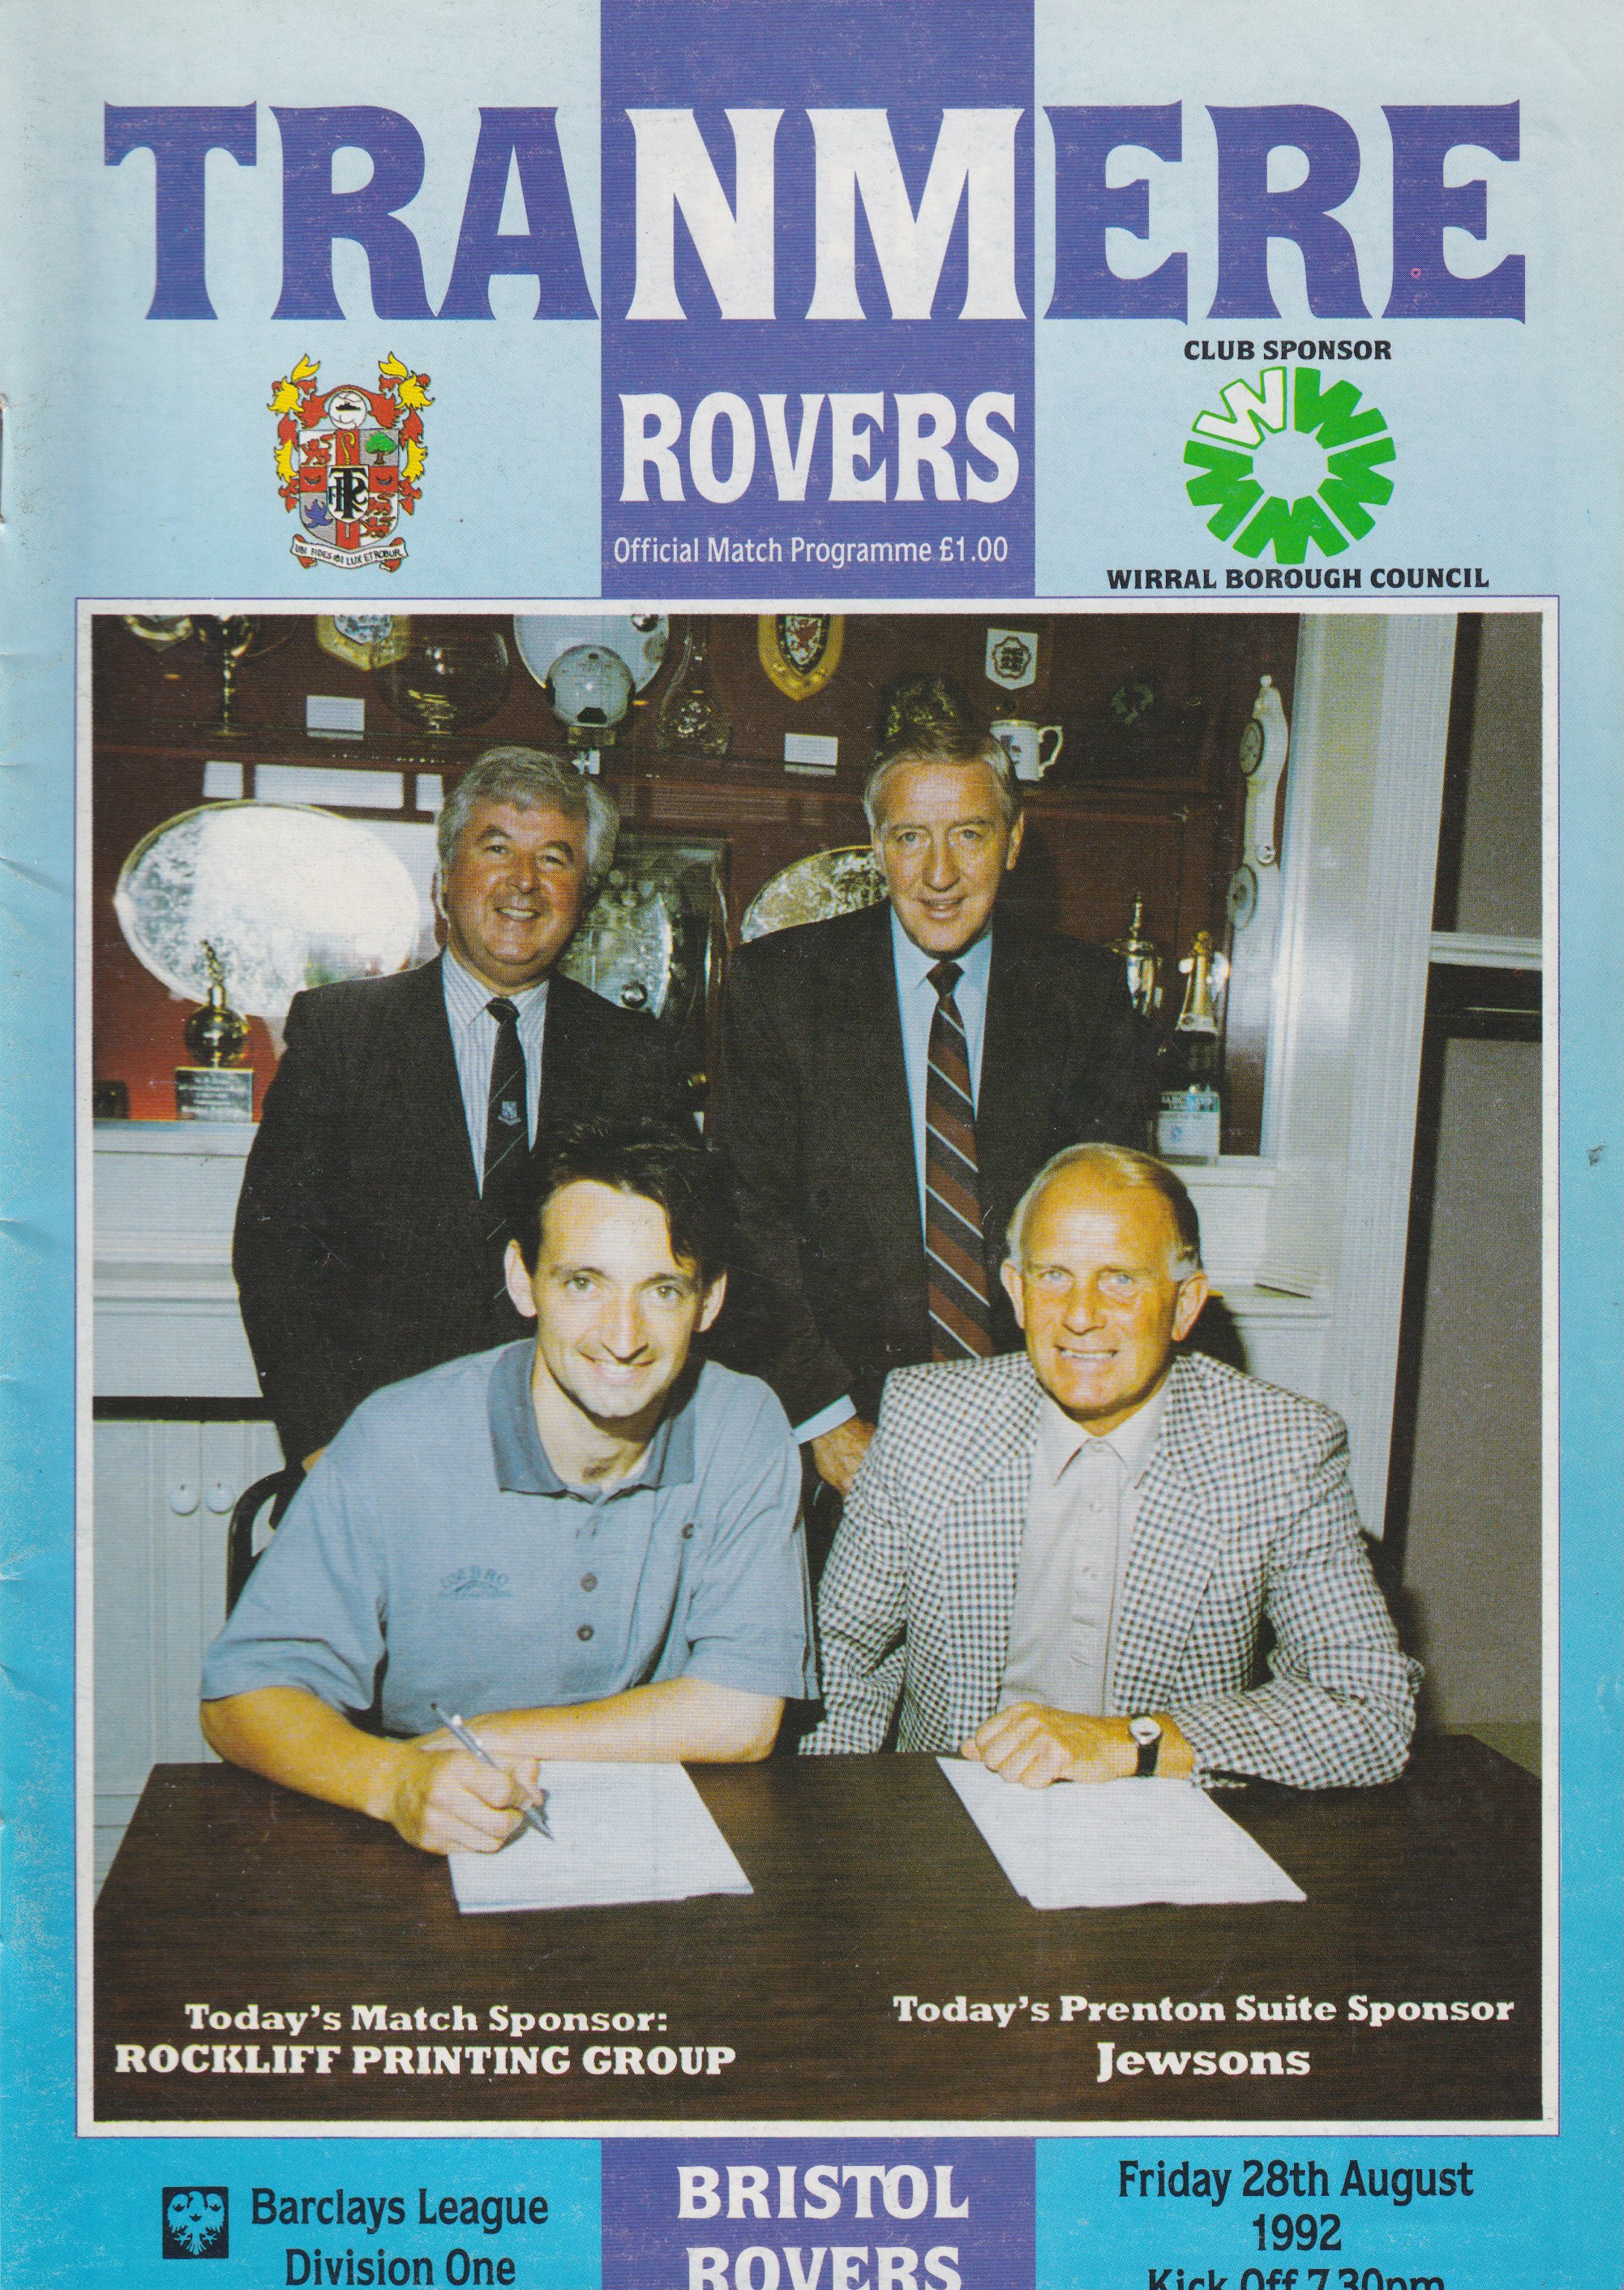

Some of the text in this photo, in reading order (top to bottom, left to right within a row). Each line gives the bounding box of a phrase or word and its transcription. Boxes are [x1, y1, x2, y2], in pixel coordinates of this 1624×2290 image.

[105, 101, 1525, 322] TRANMERE
[1184, 340, 1392, 361] CLUB SPONSOR
[619, 392, 1019, 503] ROVERS
[311, 547, 332, 560] FIDES
[346, 555, 362, 566] LUX
[614, 536, 1008, 568] Official Match Programme £1.00
[1107, 568, 1489, 590] WIRRAL BOROUGH COUNCIL
[185, 2005, 668, 2037] Today's Match Sponsor:
[893, 1995, 1515, 2028] Today's Prenton Suite Sponsor
[115, 2044, 736, 2075] ROCKLIFF PRINTING GROUP
[1097, 2043, 1310, 2082] Jewsons
[677, 2164, 969, 2219] BRISTOL
[1120, 2159, 1474, 2207] Friday 28th August
[251, 2187, 548, 2234] Barclays League
[1253, 2213, 1342, 2251] 1992
[286, 2248, 516, 2286] Division One
[686, 2245, 962, 2290] ROVERS
[1240, 2267, 1299, 2290] Off
